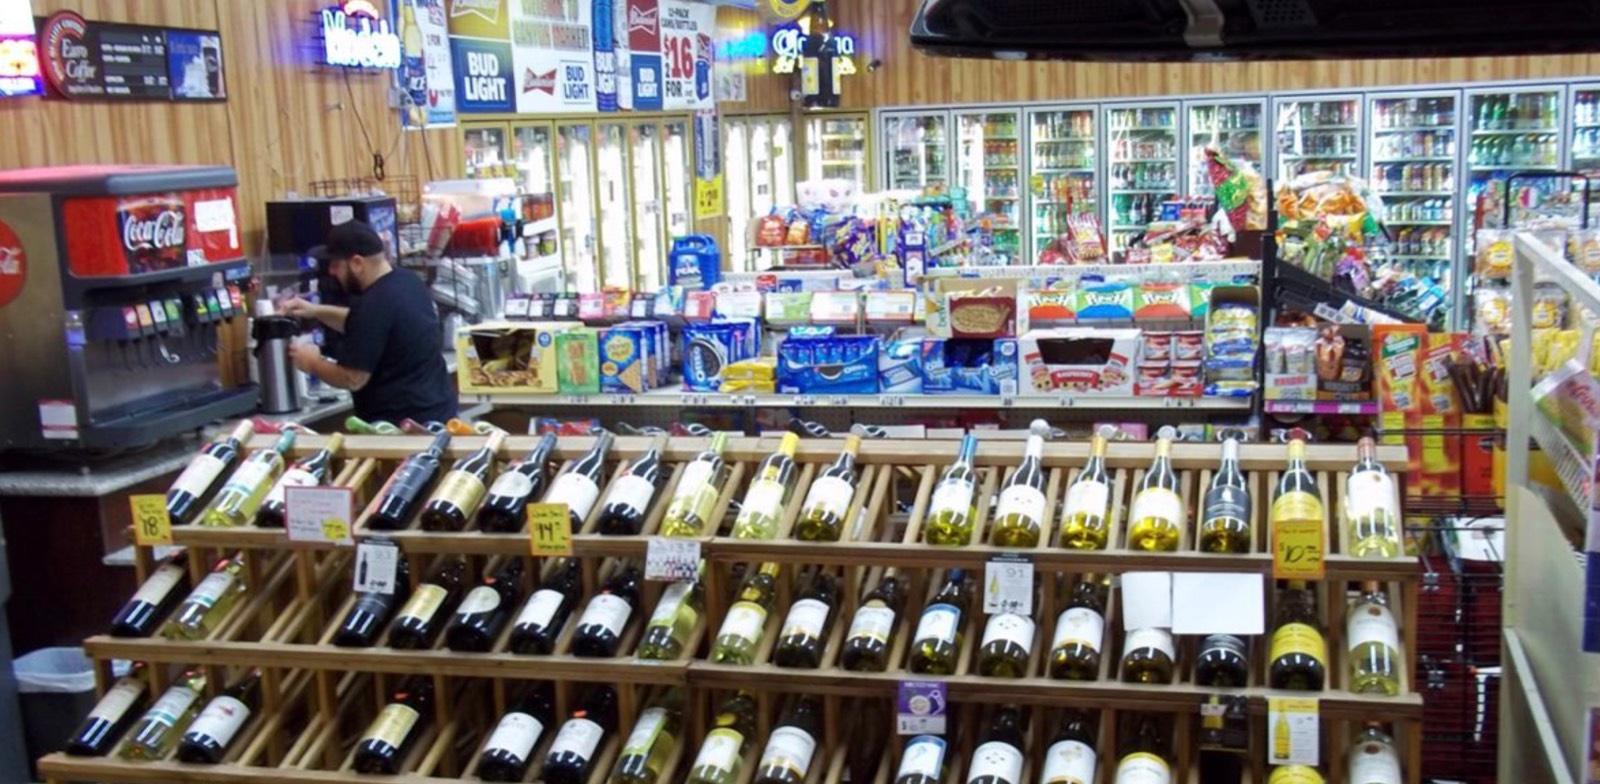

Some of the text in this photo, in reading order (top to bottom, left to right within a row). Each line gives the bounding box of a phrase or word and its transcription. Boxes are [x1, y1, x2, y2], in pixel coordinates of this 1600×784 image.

[62, 38, 89, 58] Euro
[66, 59, 98, 82] Coffee
[467, 51, 499, 76] BUD
[566, 65, 584, 81] BUD
[639, 67, 655, 83] BUD
[464, 76, 507, 101] LIGHT
[563, 83, 588, 99] LIGHT
[637, 82, 657, 97] LIGHT
[665, 80, 683, 98] FOR
[124, 210, 185, 252] Coca-Cola
